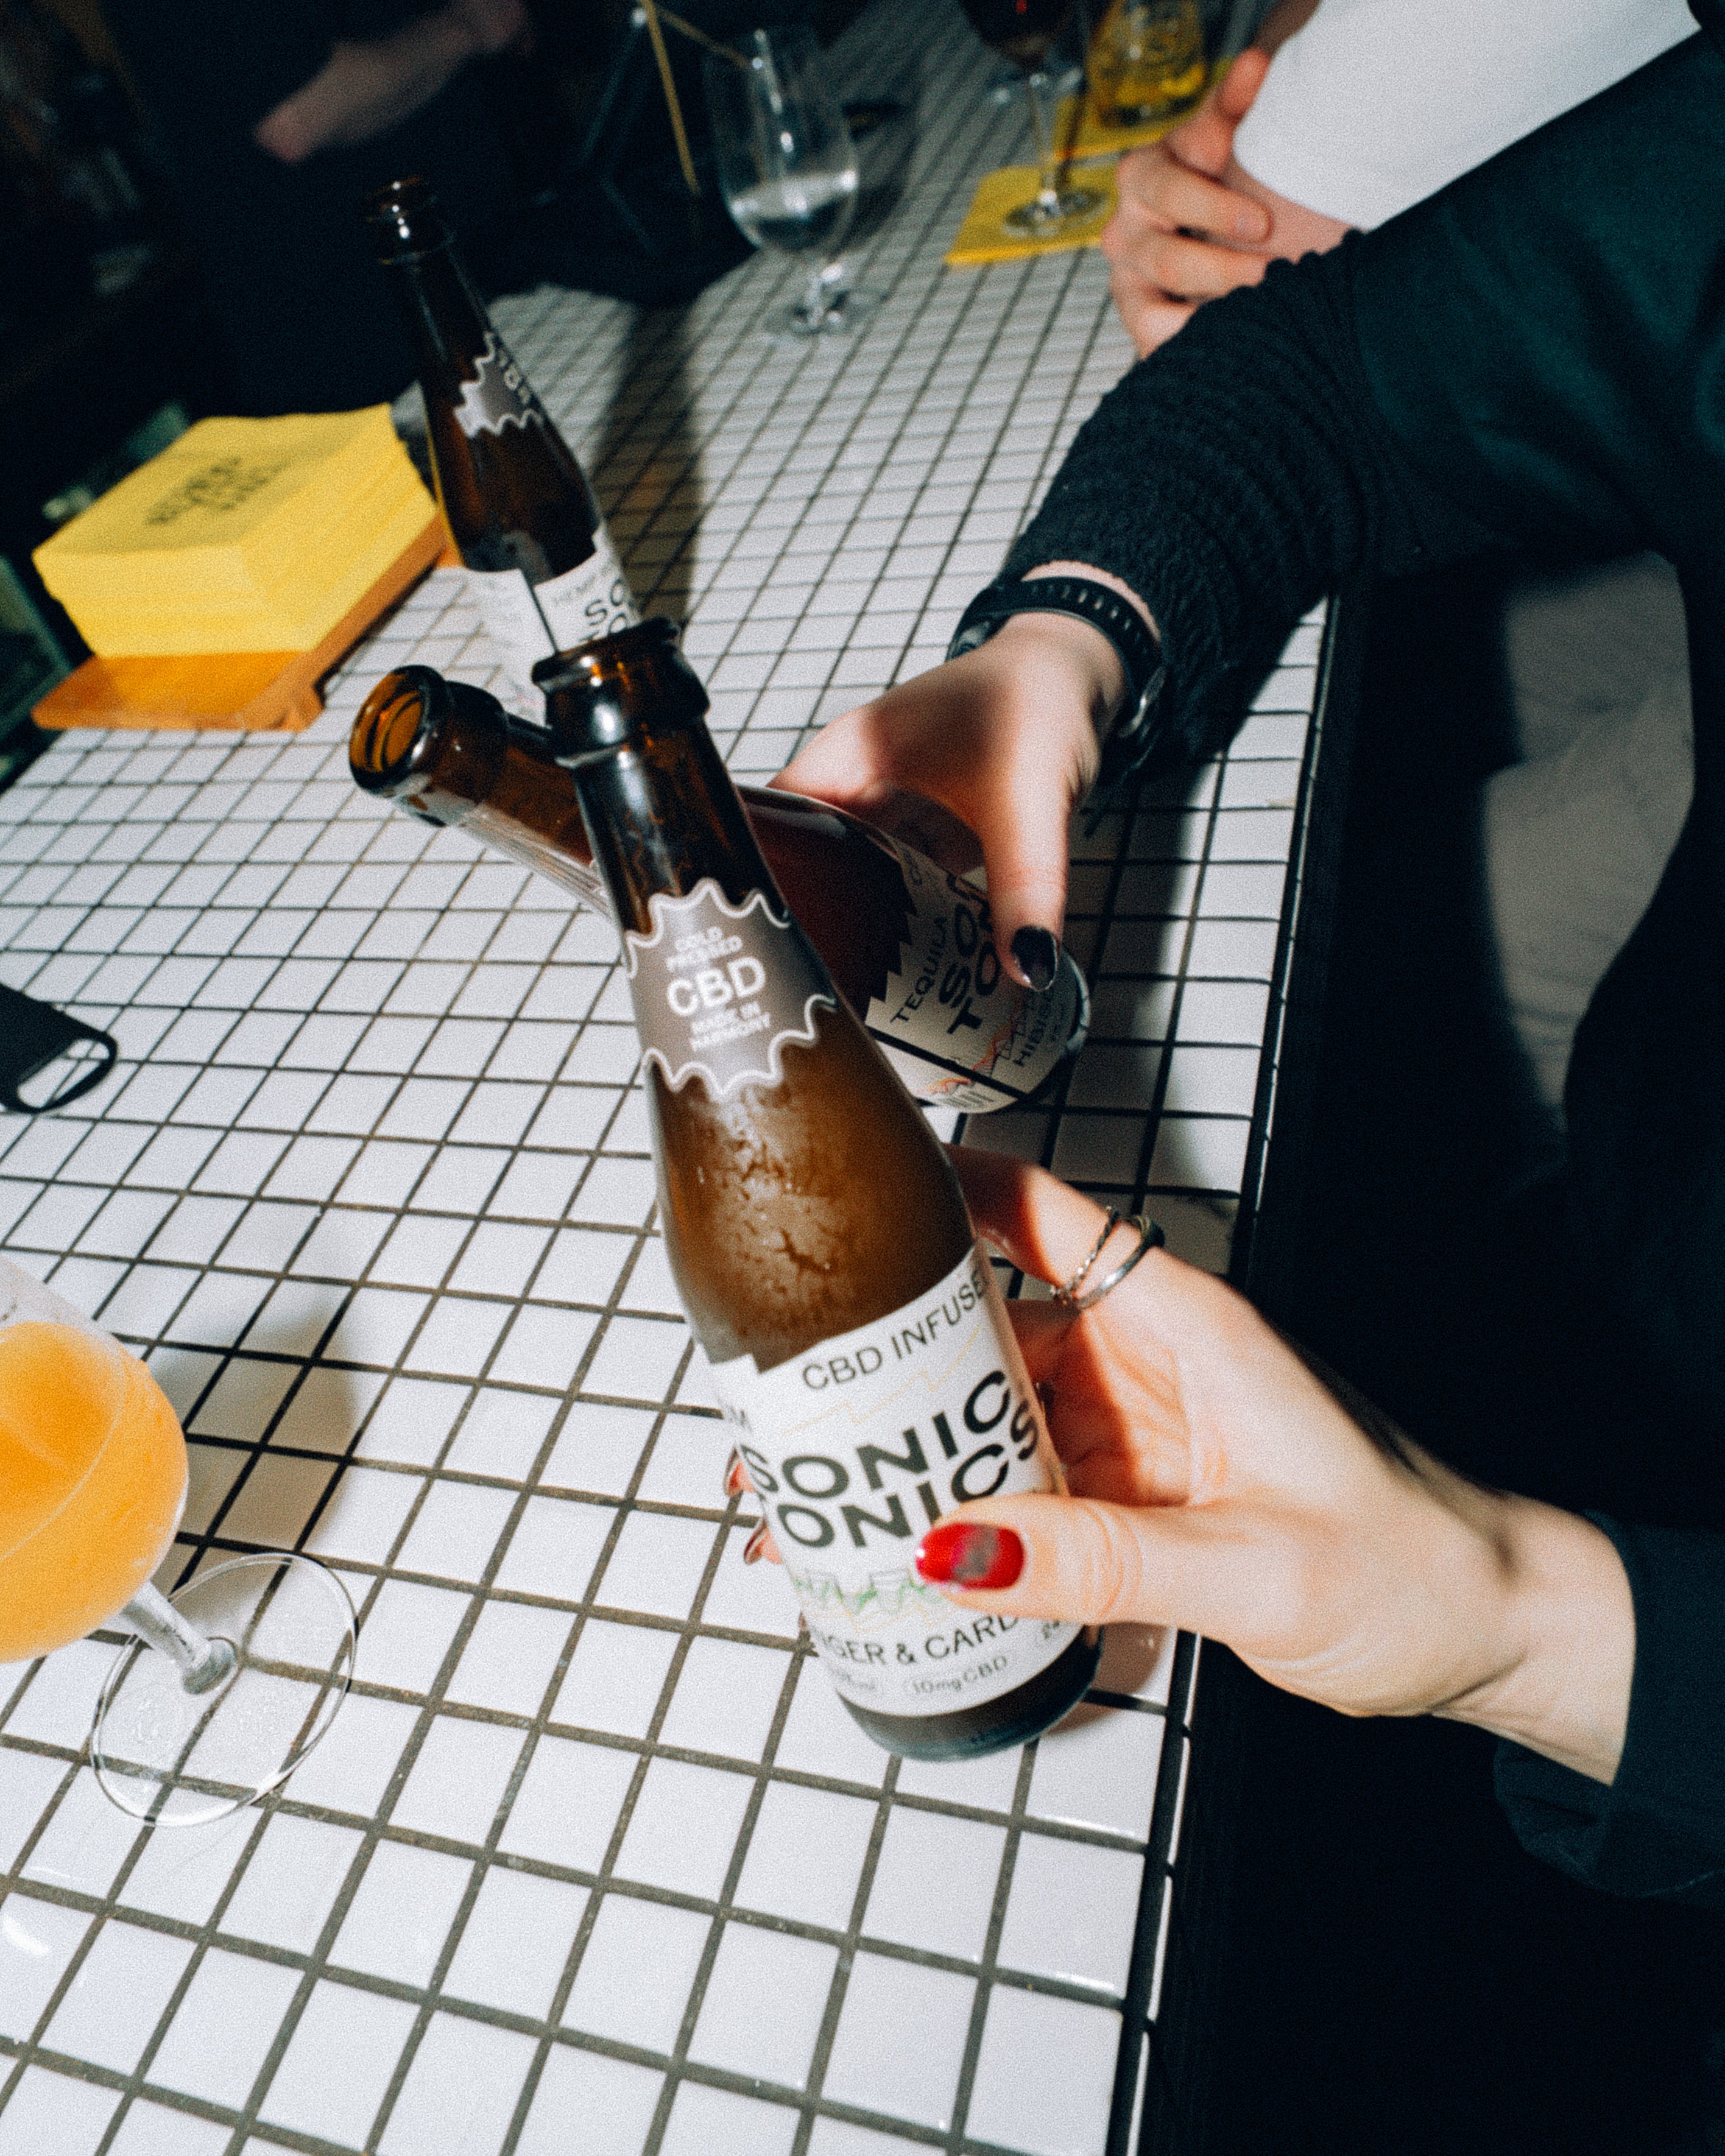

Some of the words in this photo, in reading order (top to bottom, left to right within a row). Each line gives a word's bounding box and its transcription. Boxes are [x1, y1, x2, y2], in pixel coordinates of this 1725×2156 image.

[668, 956, 766, 1016] CBD
[890, 915, 947, 1023] TEQUILA
[802, 1347, 882, 1390] CBD
[741, 1370, 1011, 1499] SONIC
[896, 1643, 917, 1665] &
